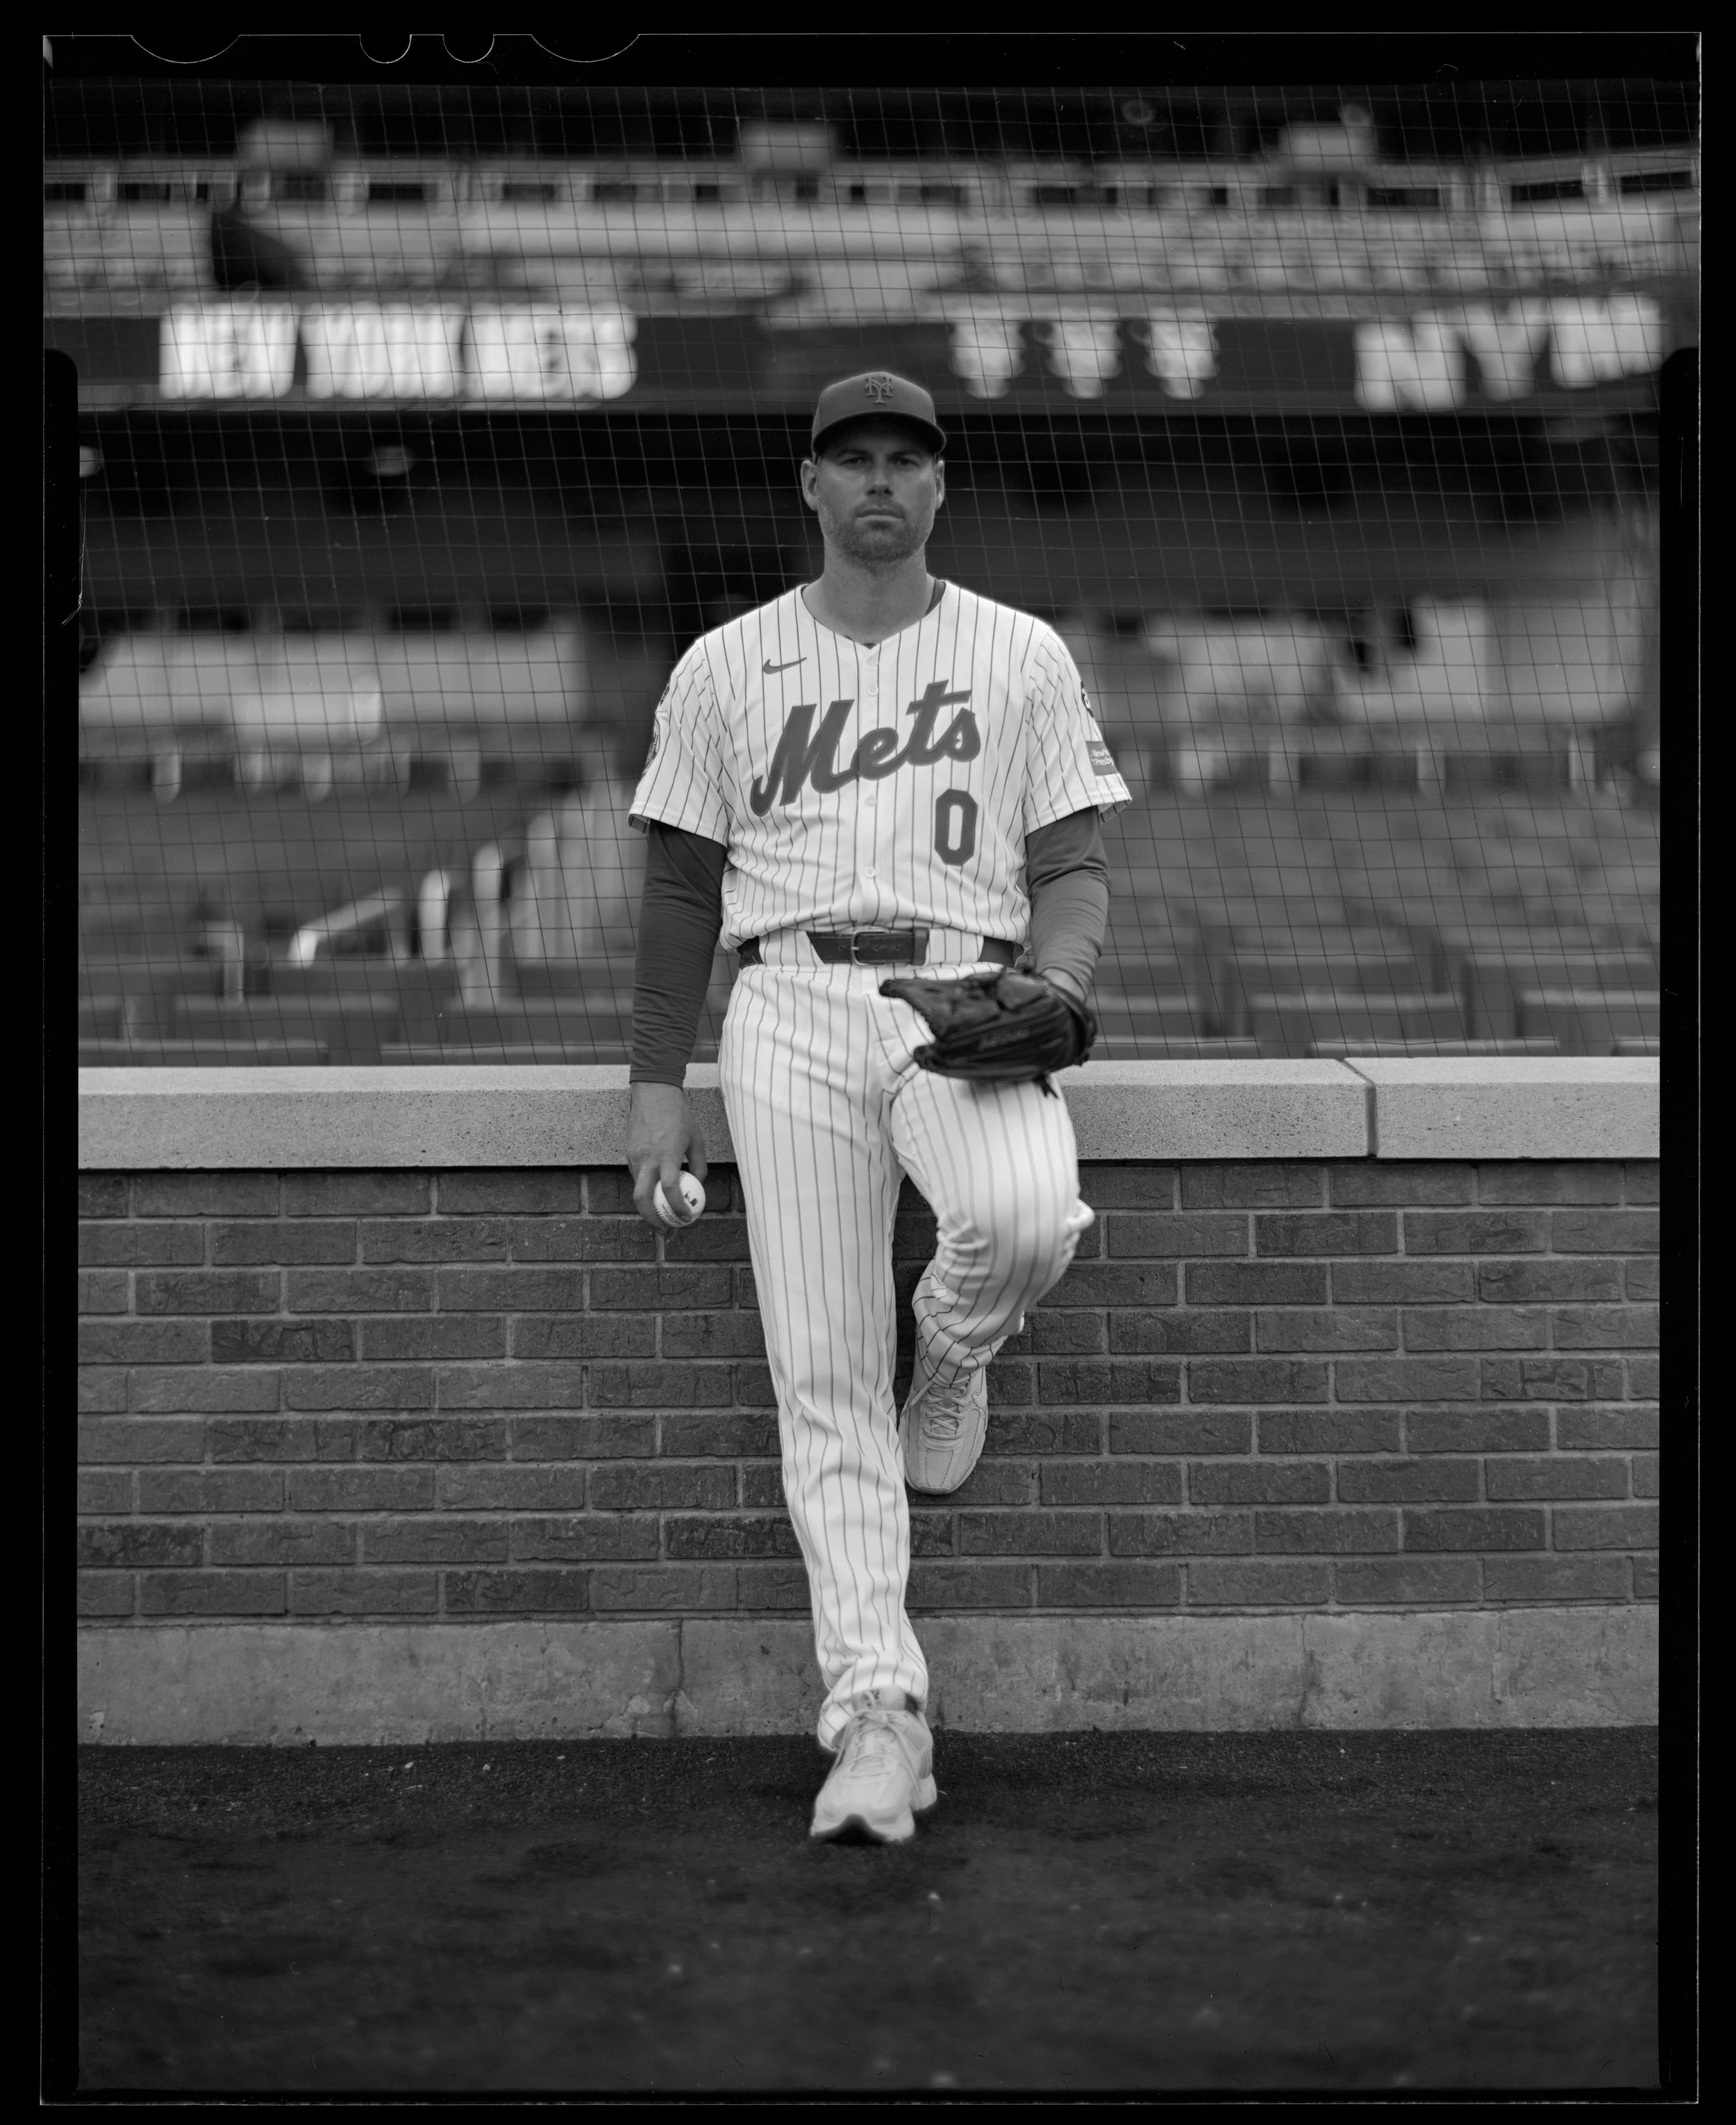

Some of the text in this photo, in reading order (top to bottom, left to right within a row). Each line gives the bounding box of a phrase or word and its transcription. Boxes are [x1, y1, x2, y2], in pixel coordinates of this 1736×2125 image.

[865, 376, 894, 405] NY
[750, 680, 981, 817] Mets
[935, 789, 978, 867] 0
